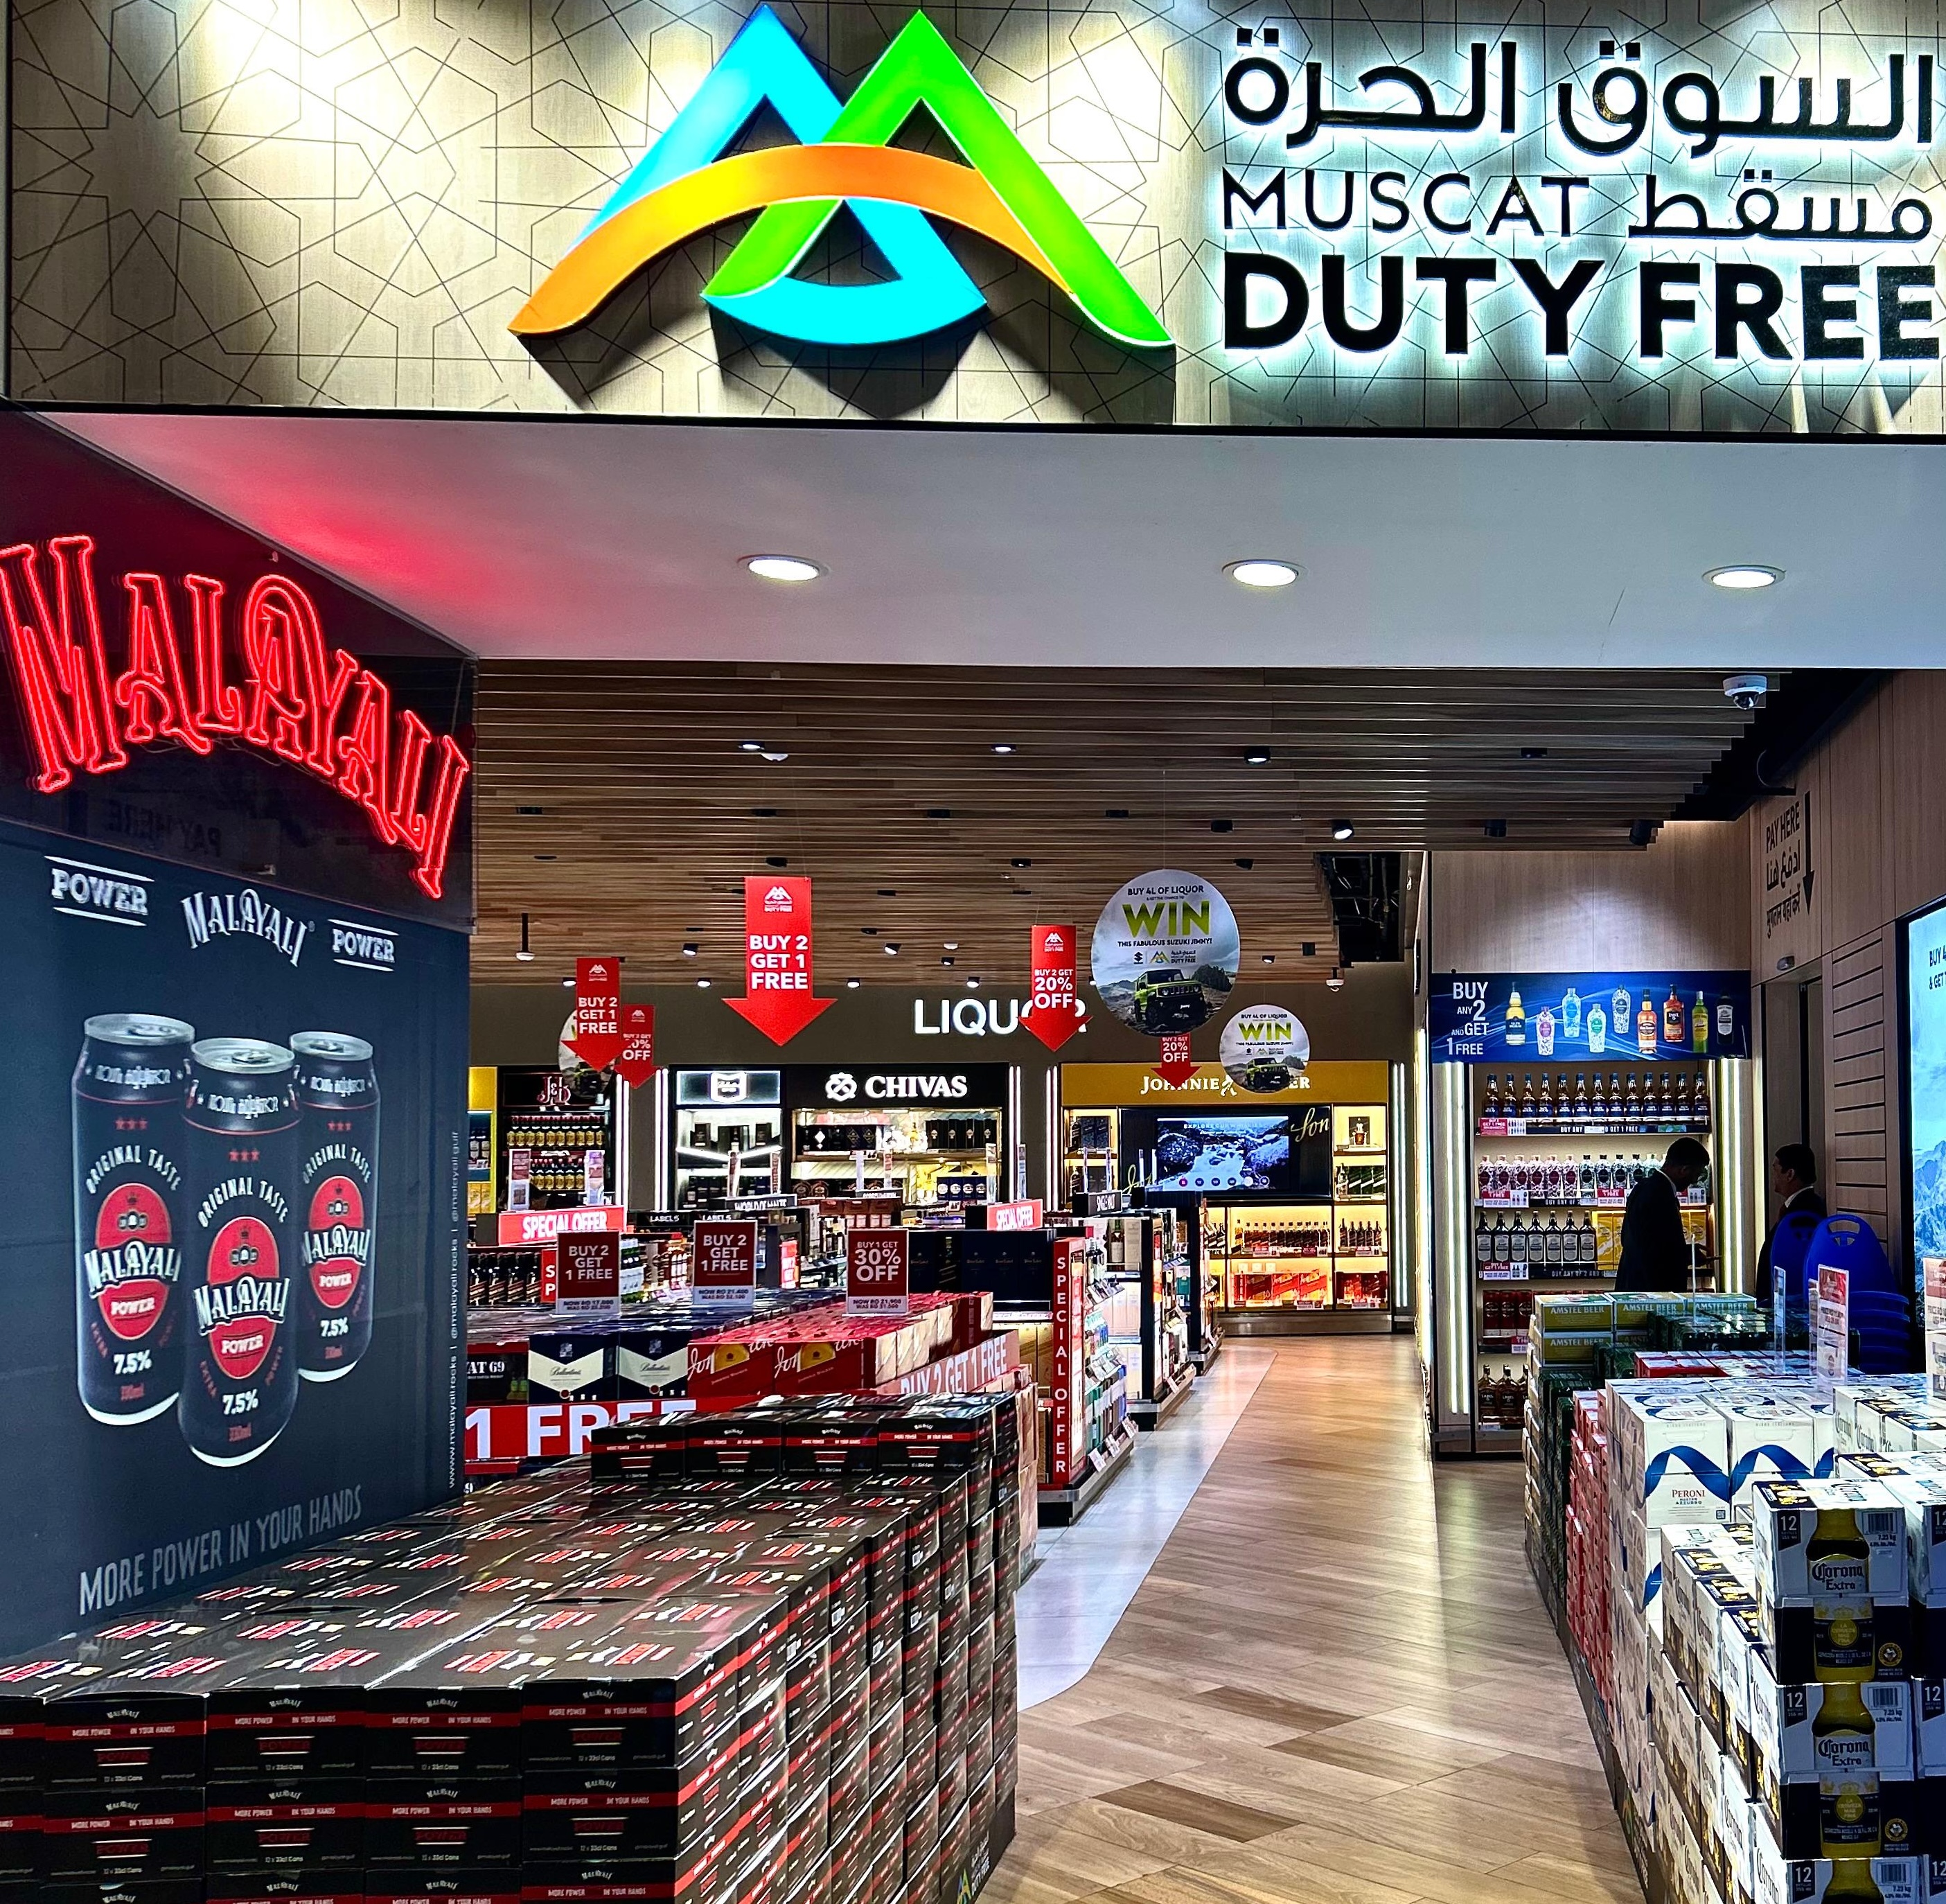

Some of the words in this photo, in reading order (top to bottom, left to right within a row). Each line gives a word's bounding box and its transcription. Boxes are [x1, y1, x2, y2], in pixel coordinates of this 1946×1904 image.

[1225, 28, 1516, 149] الحرة
[1558, 39, 1933, 159] السوق
[1223, 168, 1589, 238] MUSCAT
[1628, 169, 1933, 241] مسقط
[1225, 252, 1605, 358] DUTY
[1639, 262, 1940, 362] FREE
[0, 536, 469, 899] MALAYALI
[1767, 818, 1779, 853] PAY
[1780, 801, 1799, 843] HERE
[1767, 859, 1778, 891] هنا
[51, 867, 149, 915] POWER
[1171, 885, 1204, 894] LIQUOR
[1122, 901, 1210, 937] WIN
[332, 928, 395, 962] POWER
[750, 935, 791, 950] BUY
[796, 935, 808, 950] 2
[750, 953, 790, 969] GET
[795, 954, 805, 968] 1
[1929, 947, 1941, 967] BUY
[751, 972, 808, 989] FREE
[1034, 977, 1073, 991] 20%
[1934, 972, 1943, 988] GET
[1453, 982, 1488, 999] BUY
[578, 997, 606, 1007] BUY
[609, 997, 617, 1007] 2
[1034, 993, 1073, 1009] OFF
[579, 1010, 605, 1019] GET
[610, 1010, 615, 1019] 1
[914, 998, 1086, 1036] LIQU
[1457, 1006, 1472, 1014] ANY
[1473, 1000, 1486, 1021] 2
[579, 1023, 617, 1034] FREE
[1238, 1022, 1291, 1041] WIN
[1465, 1023, 1489, 1035] GET
[1163, 1043, 1188, 1052] 20%
[1447, 1037, 1453, 1055] 1
[1456, 1043, 1484, 1055] FREE
[623, 1050, 651, 1060] OFF
[1163, 1052, 1188, 1063] OFF
[865, 1075, 968, 1099] CHIVAS
[86, 1145, 141, 1194] ORIGINAL
[148, 1149, 182, 1191] TASTE
[303, 1143, 346, 1185] ORIGINAL
[351, 1147, 371, 1183] TASTE
[197, 1176, 254, 1228] ORIGINAL
[259, 1180, 289, 1224] TASTE
[522, 1214, 570, 1240] SPECIAL
[572, 1211, 607, 1231] OFFER
[996, 1207, 1014, 1230] SPECIAL
[1016, 1206, 1034, 1228] OFFER
[703, 1235, 734, 1246] BUY
[738, 1235, 747, 1246] 2
[568, 1246, 599, 1257] BUY
[601, 1245, 609, 1255] 2
[710, 1248, 740, 1258] GET
[854, 1249, 901, 1265] 30%
[85, 1240, 182, 1293] MALAYALI
[575, 1258, 603, 1268] GET
[701, 1260, 708, 1271] 1
[711, 1260, 748, 1271] FREE
[319, 1273, 353, 1287] POWER
[565, 1270, 572, 1280] 1
[578, 1269, 613, 1280] FREE
[856, 1265, 899, 1282] OFF
[110, 1297, 155, 1316] POWER
[193, 1276, 290, 1330] MALAYALI
[1584, 1305, 1605, 1314] BEER
[1656, 1303, 1677, 1311] BEER
[1696, 1302, 1728, 1310] AMSTEL
[1055, 1256, 1067, 1376] SPECIAL
[320, 1317, 349, 1337] 7.5%
[221, 1334, 264, 1355] POWER
[1550, 1338, 1582, 1346] AMSTEL
[113, 1350, 152, 1375] 7.5%
[489, 1361, 505, 1373] 69
[935, 1364, 942, 1394] 2
[945, 1353, 968, 1394] GET
[971, 1349, 978, 1388] 1
[981, 1335, 1007, 1384] FREE
[222, 1389, 259, 1415] 7.5%
[466, 1408, 490, 1459] 1
[1054, 1388, 1068, 1473] OFFER
[1672, 1489, 1706, 1498] PERONI
[1780, 1516, 1798, 1531] 12
[80, 1552, 146, 1616] MORE
[151, 1528, 222, 1590] POWER
[229, 1520, 250, 1564] IN
[255, 1504, 303, 1553] YOUR
[308, 1483, 362, 1536] HANDS
[1812, 1563, 1864, 1583] Corona
[1825, 1579, 1856, 1591] Extra
[1787, 1693, 1803, 1707] 12
[1925, 1686, 1941, 1702] 12
[1818, 1739, 1870, 1758] Corona
[1832, 1755, 1862, 1766] Extra
[1795, 1867, 1812, 1883] 12
[1932, 1860, 1946, 1876] 12
